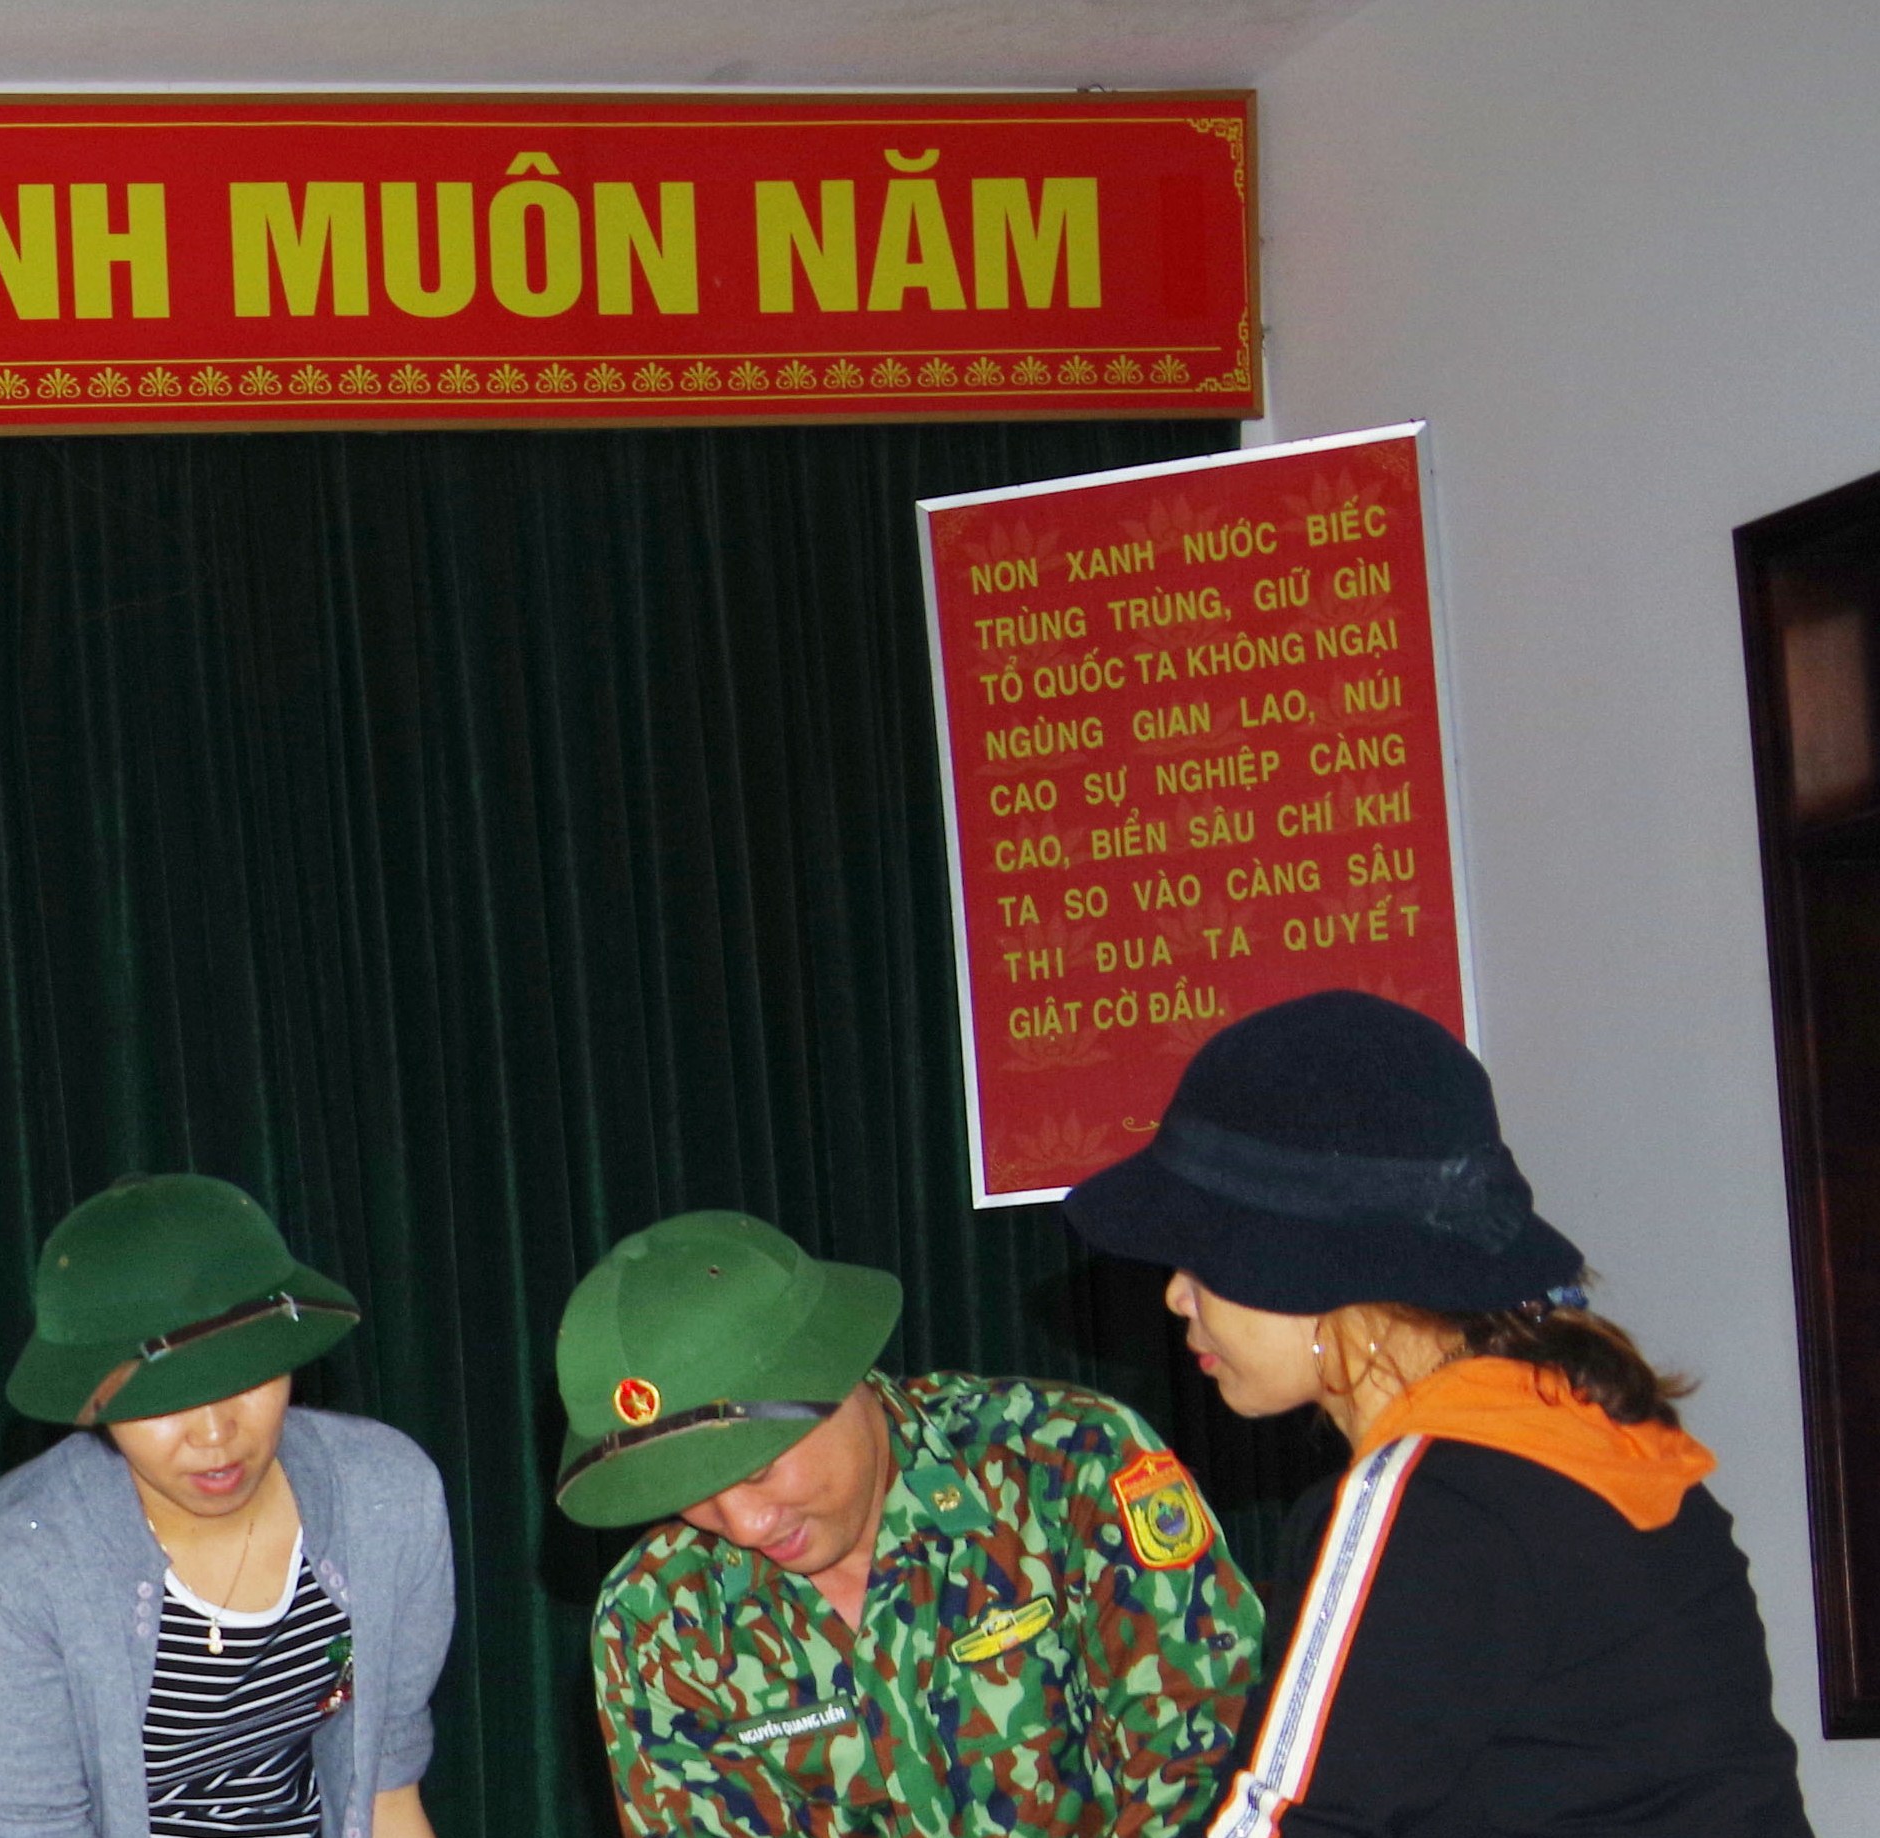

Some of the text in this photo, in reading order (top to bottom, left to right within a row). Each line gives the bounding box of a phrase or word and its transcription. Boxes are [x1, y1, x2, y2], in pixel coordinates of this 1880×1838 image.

[229, 152, 699, 318] MUÔN
[755, 149, 1101, 313] NĂM
[971, 559, 1038, 595] NON
[1066, 540, 1154, 580] XANH
[1306, 497, 1386, 546] BIẾC
[975, 557, 1391, 649] TRÙNG TRÙNG, GIỮ GÌN
[980, 619, 1398, 703] TỔ QUỐC TA KHÔNG NGẠI
[1133, 704, 1211, 741] GIAN
[1240, 690, 1316, 727] LAO,
[1344, 669, 1401, 712] NÚI
[990, 734, 1405, 816] CAO SỰ NGHIỆP CÀNG
[995, 781, 1411, 872] CAO, BIỂN SÂU CHÍ KHÍ
[999, 845, 1414, 925] TA SO VÀO CÀNG SÂU
[1004, 896, 1419, 983] THI ĐUA TA QUYẾT
[1009, 978, 1224, 1042] GIẬT CỜ ĐẦU.
